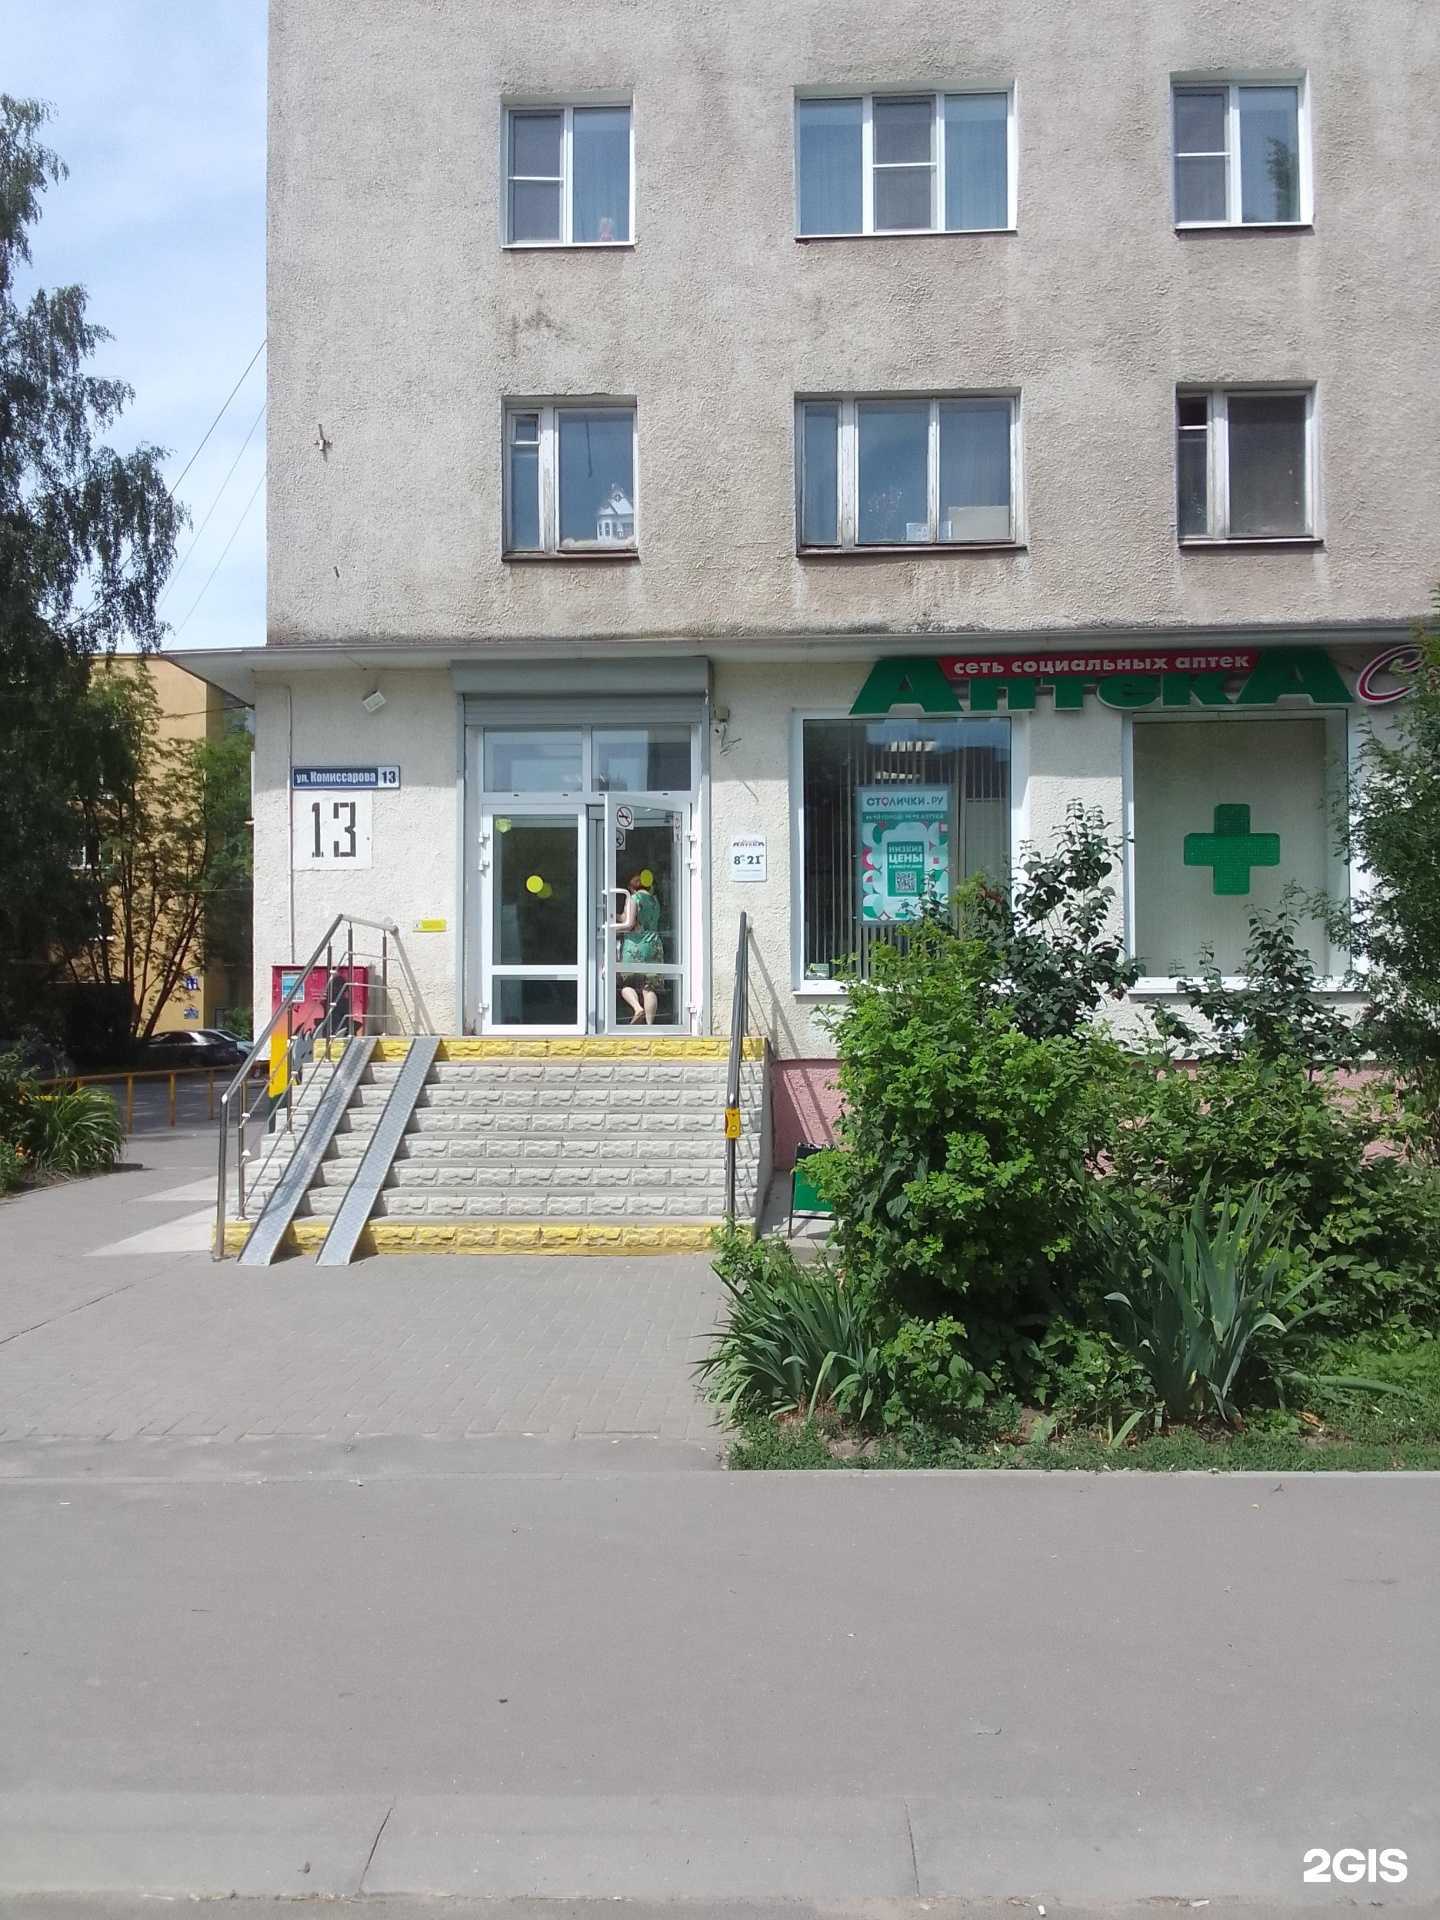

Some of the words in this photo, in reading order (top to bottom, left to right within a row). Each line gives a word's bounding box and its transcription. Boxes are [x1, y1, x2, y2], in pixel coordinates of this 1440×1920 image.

[954, 662, 1004, 674] сеть
[1011, 656, 1168, 673] социальных
[1175, 655, 1249, 669] аптек
[296, 774, 308, 783] ул.
[310, 771, 376, 783] Комиссарова
[382, 771, 396, 784] 13
[311, 802, 356, 857] 13
[888, 853, 923, 864] ЦЕНЫ
